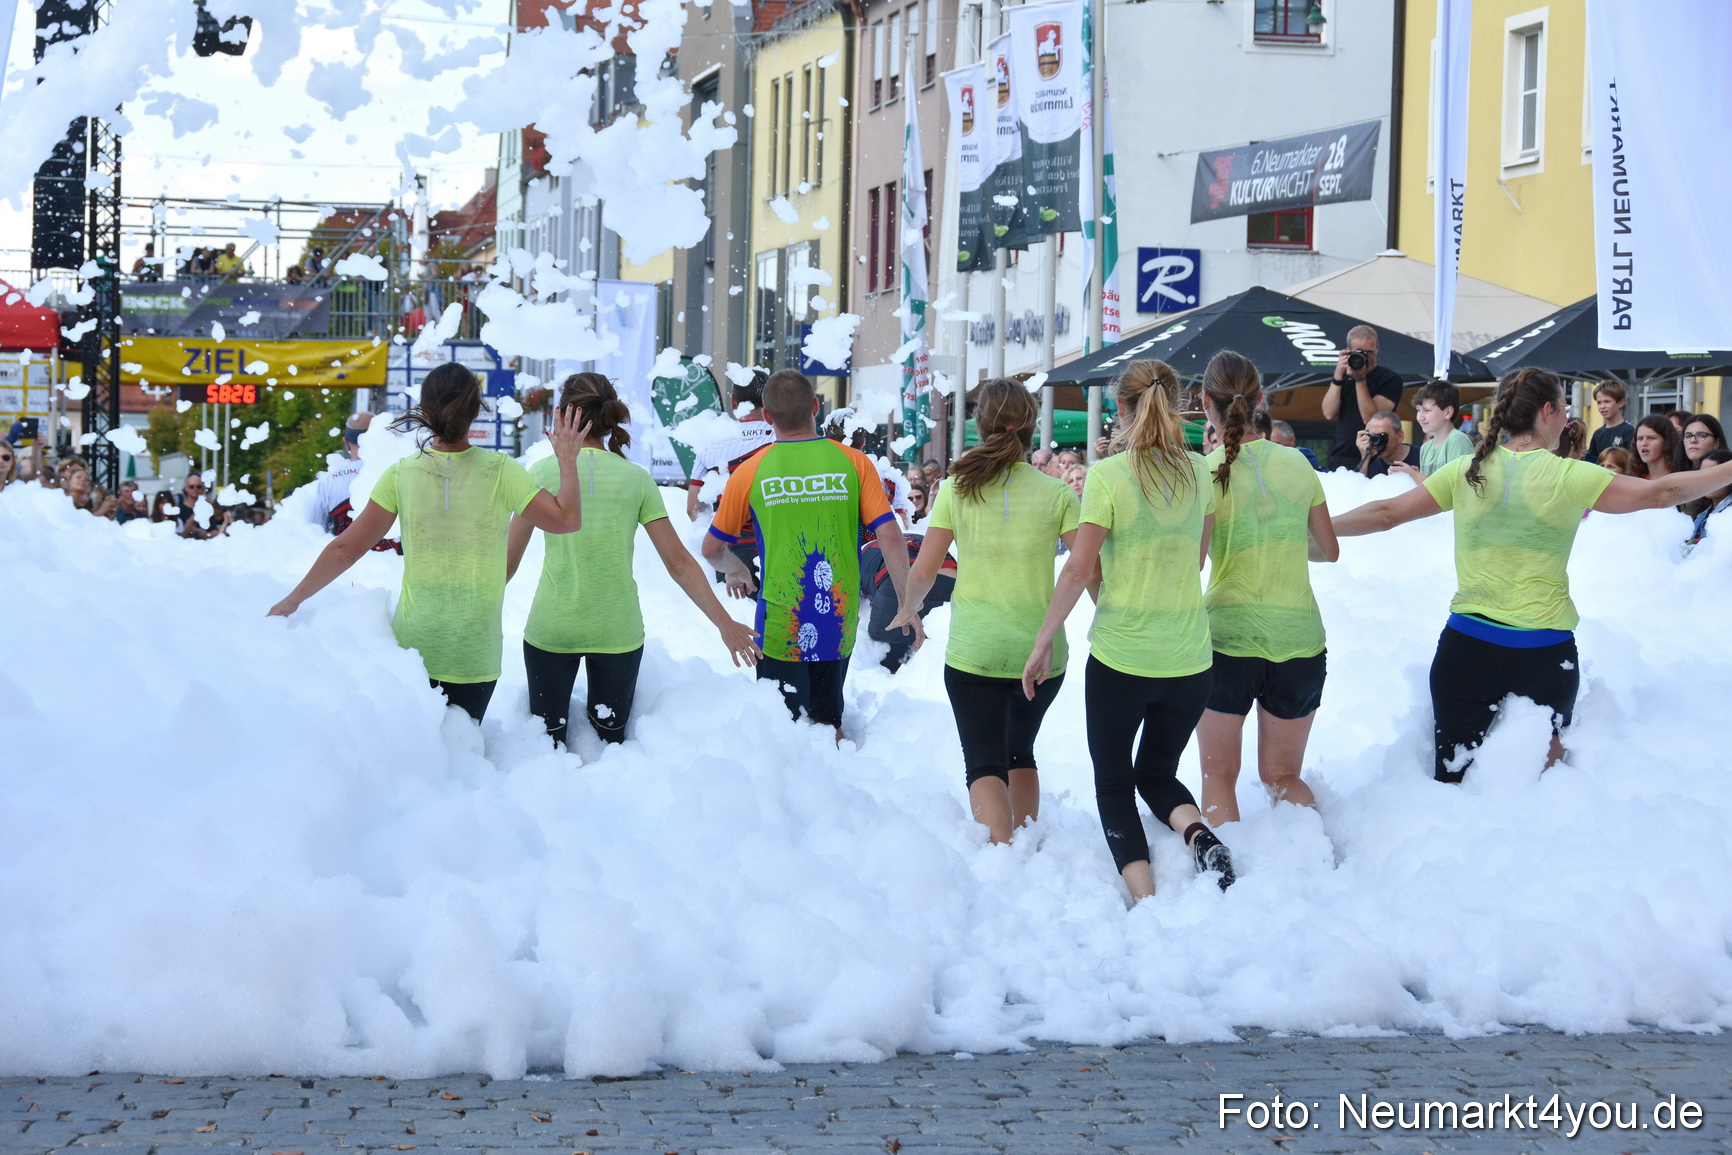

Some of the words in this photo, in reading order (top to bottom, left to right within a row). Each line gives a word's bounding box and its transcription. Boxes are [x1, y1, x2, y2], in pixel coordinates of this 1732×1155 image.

[1324, 134, 1348, 171] 28.
[1229, 169, 1314, 206] KULTURNACHT
[1318, 173, 1342, 196] SEPT.
[121, 295, 188, 310] BOCK
[183, 348, 258, 374] ZIEL
[761, 473, 848, 500] BOCK
[765, 497, 789, 507] inspired
